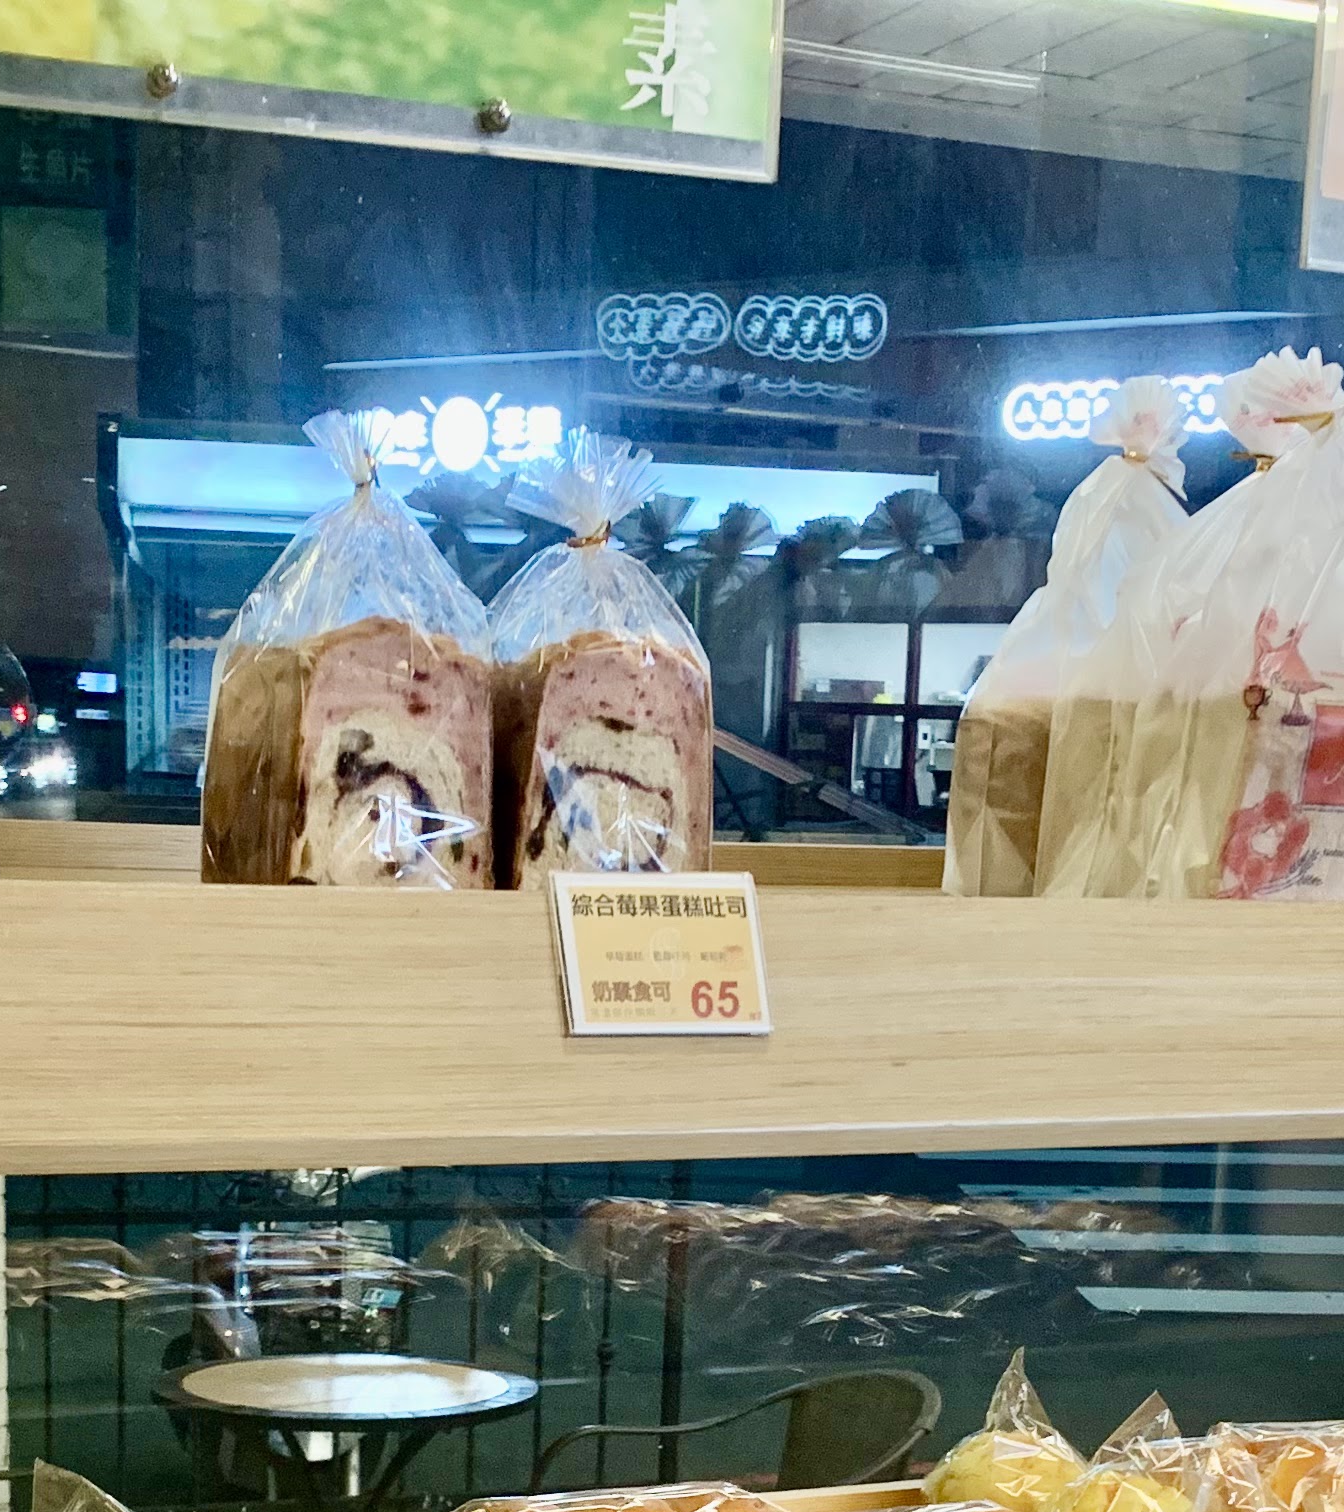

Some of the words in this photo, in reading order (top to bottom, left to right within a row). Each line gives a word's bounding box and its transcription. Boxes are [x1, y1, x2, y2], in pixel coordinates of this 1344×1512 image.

[571, 894, 747, 918] 綜合莓果蛋糕吐司
[691, 981, 739, 1018] 65
